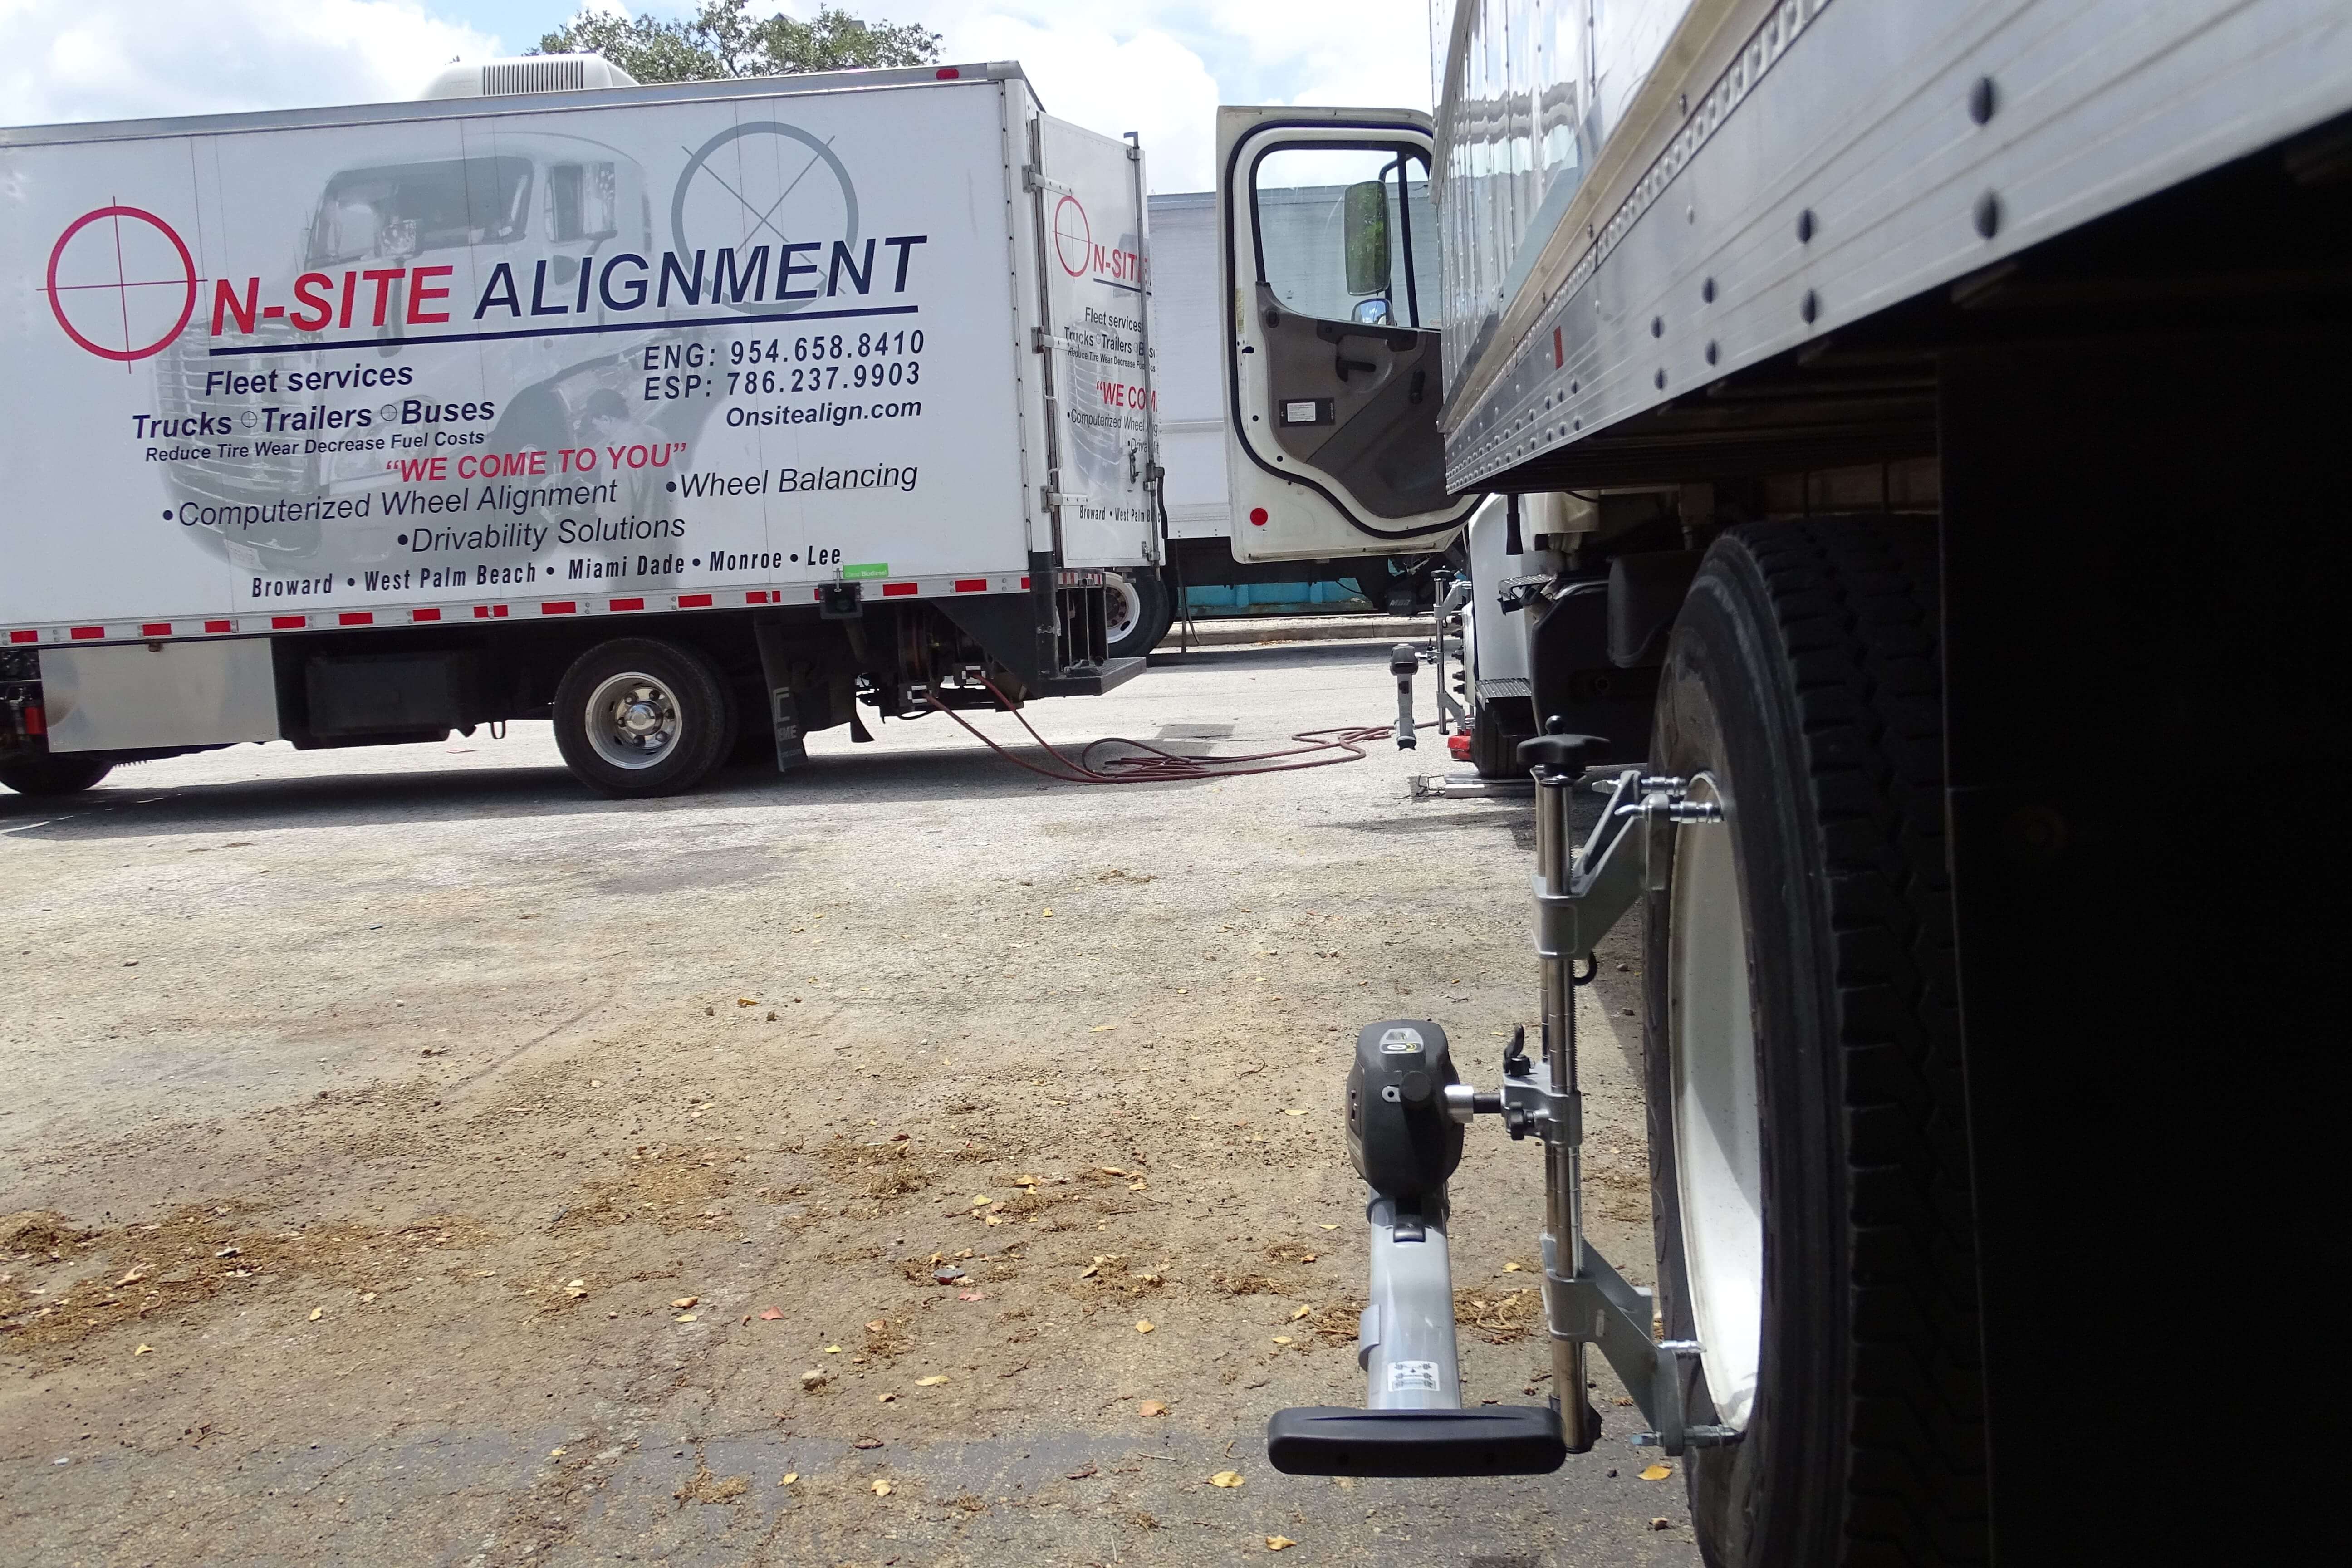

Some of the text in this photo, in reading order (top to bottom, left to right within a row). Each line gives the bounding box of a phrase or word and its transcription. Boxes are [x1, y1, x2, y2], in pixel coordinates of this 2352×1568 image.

[473, 235, 927, 319] ALIGNMENT
[1085, 306, 1142, 333] Fleet services
[644, 330, 923, 370] ENG: 954.658.8410
[1064, 326, 1094, 347] Trucks
[1102, 333, 1132, 354] Trailers
[1089, 351, 1099, 362] Tire
[1100, 353, 1113, 364] Wear
[1113, 356, 1136, 368] Decrease
[206, 363, 412, 396] Fleet services
[645, 362, 919, 400] ESP: 786.237.9903
[133, 400, 494, 438] Trucks Trailers Buses
[727, 402, 921, 426] Onsitealign.com
[1124, 416, 1145, 432] Wheel
[147, 431, 484, 461] Reduce Tire Wear Decrease Fuel Costs
[459, 451, 546, 479] COME
[559, 448, 596, 472] TO
[681, 463, 917, 497] Wheel Balancing
[180, 480, 617, 530] Computerized Wheel Alignment
[1079, 505, 1106, 521] Broward
[1115, 507, 1129, 522] West
[1131, 508, 1145, 522] Palm
[412, 515, 685, 553] Drivability Solutions
[253, 546, 840, 597] Broward West Palm Beach Miami Dade Monroe Lee
